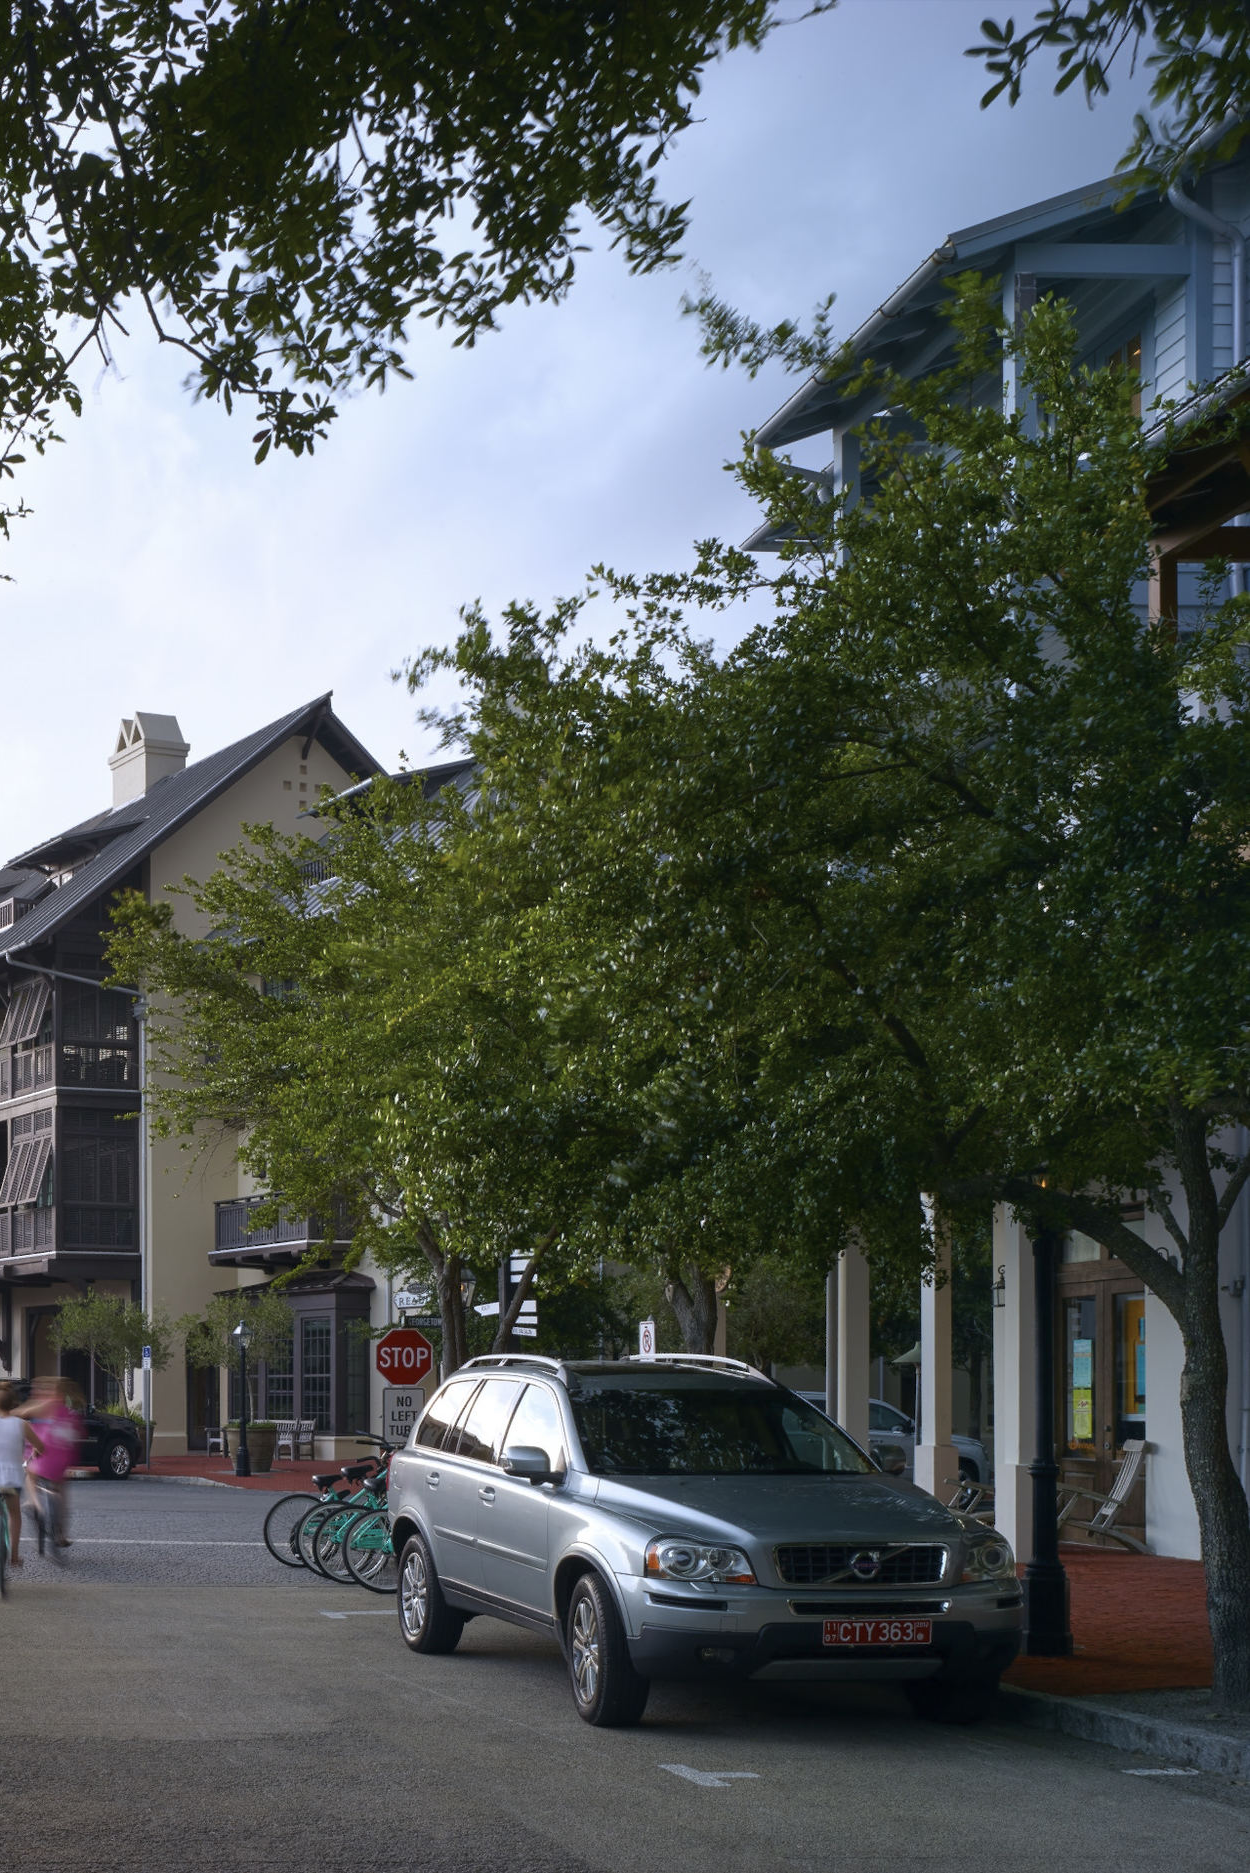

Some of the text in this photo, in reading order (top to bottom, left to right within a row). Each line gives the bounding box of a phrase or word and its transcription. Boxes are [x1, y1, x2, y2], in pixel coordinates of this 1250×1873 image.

[379, 1346, 429, 1369] STOP
[396, 1395, 412, 1407] NO
[391, 1410, 418, 1422] LEFT
[389, 1425, 411, 1437] TUR
[840, 1622, 914, 1642] CTY 363
